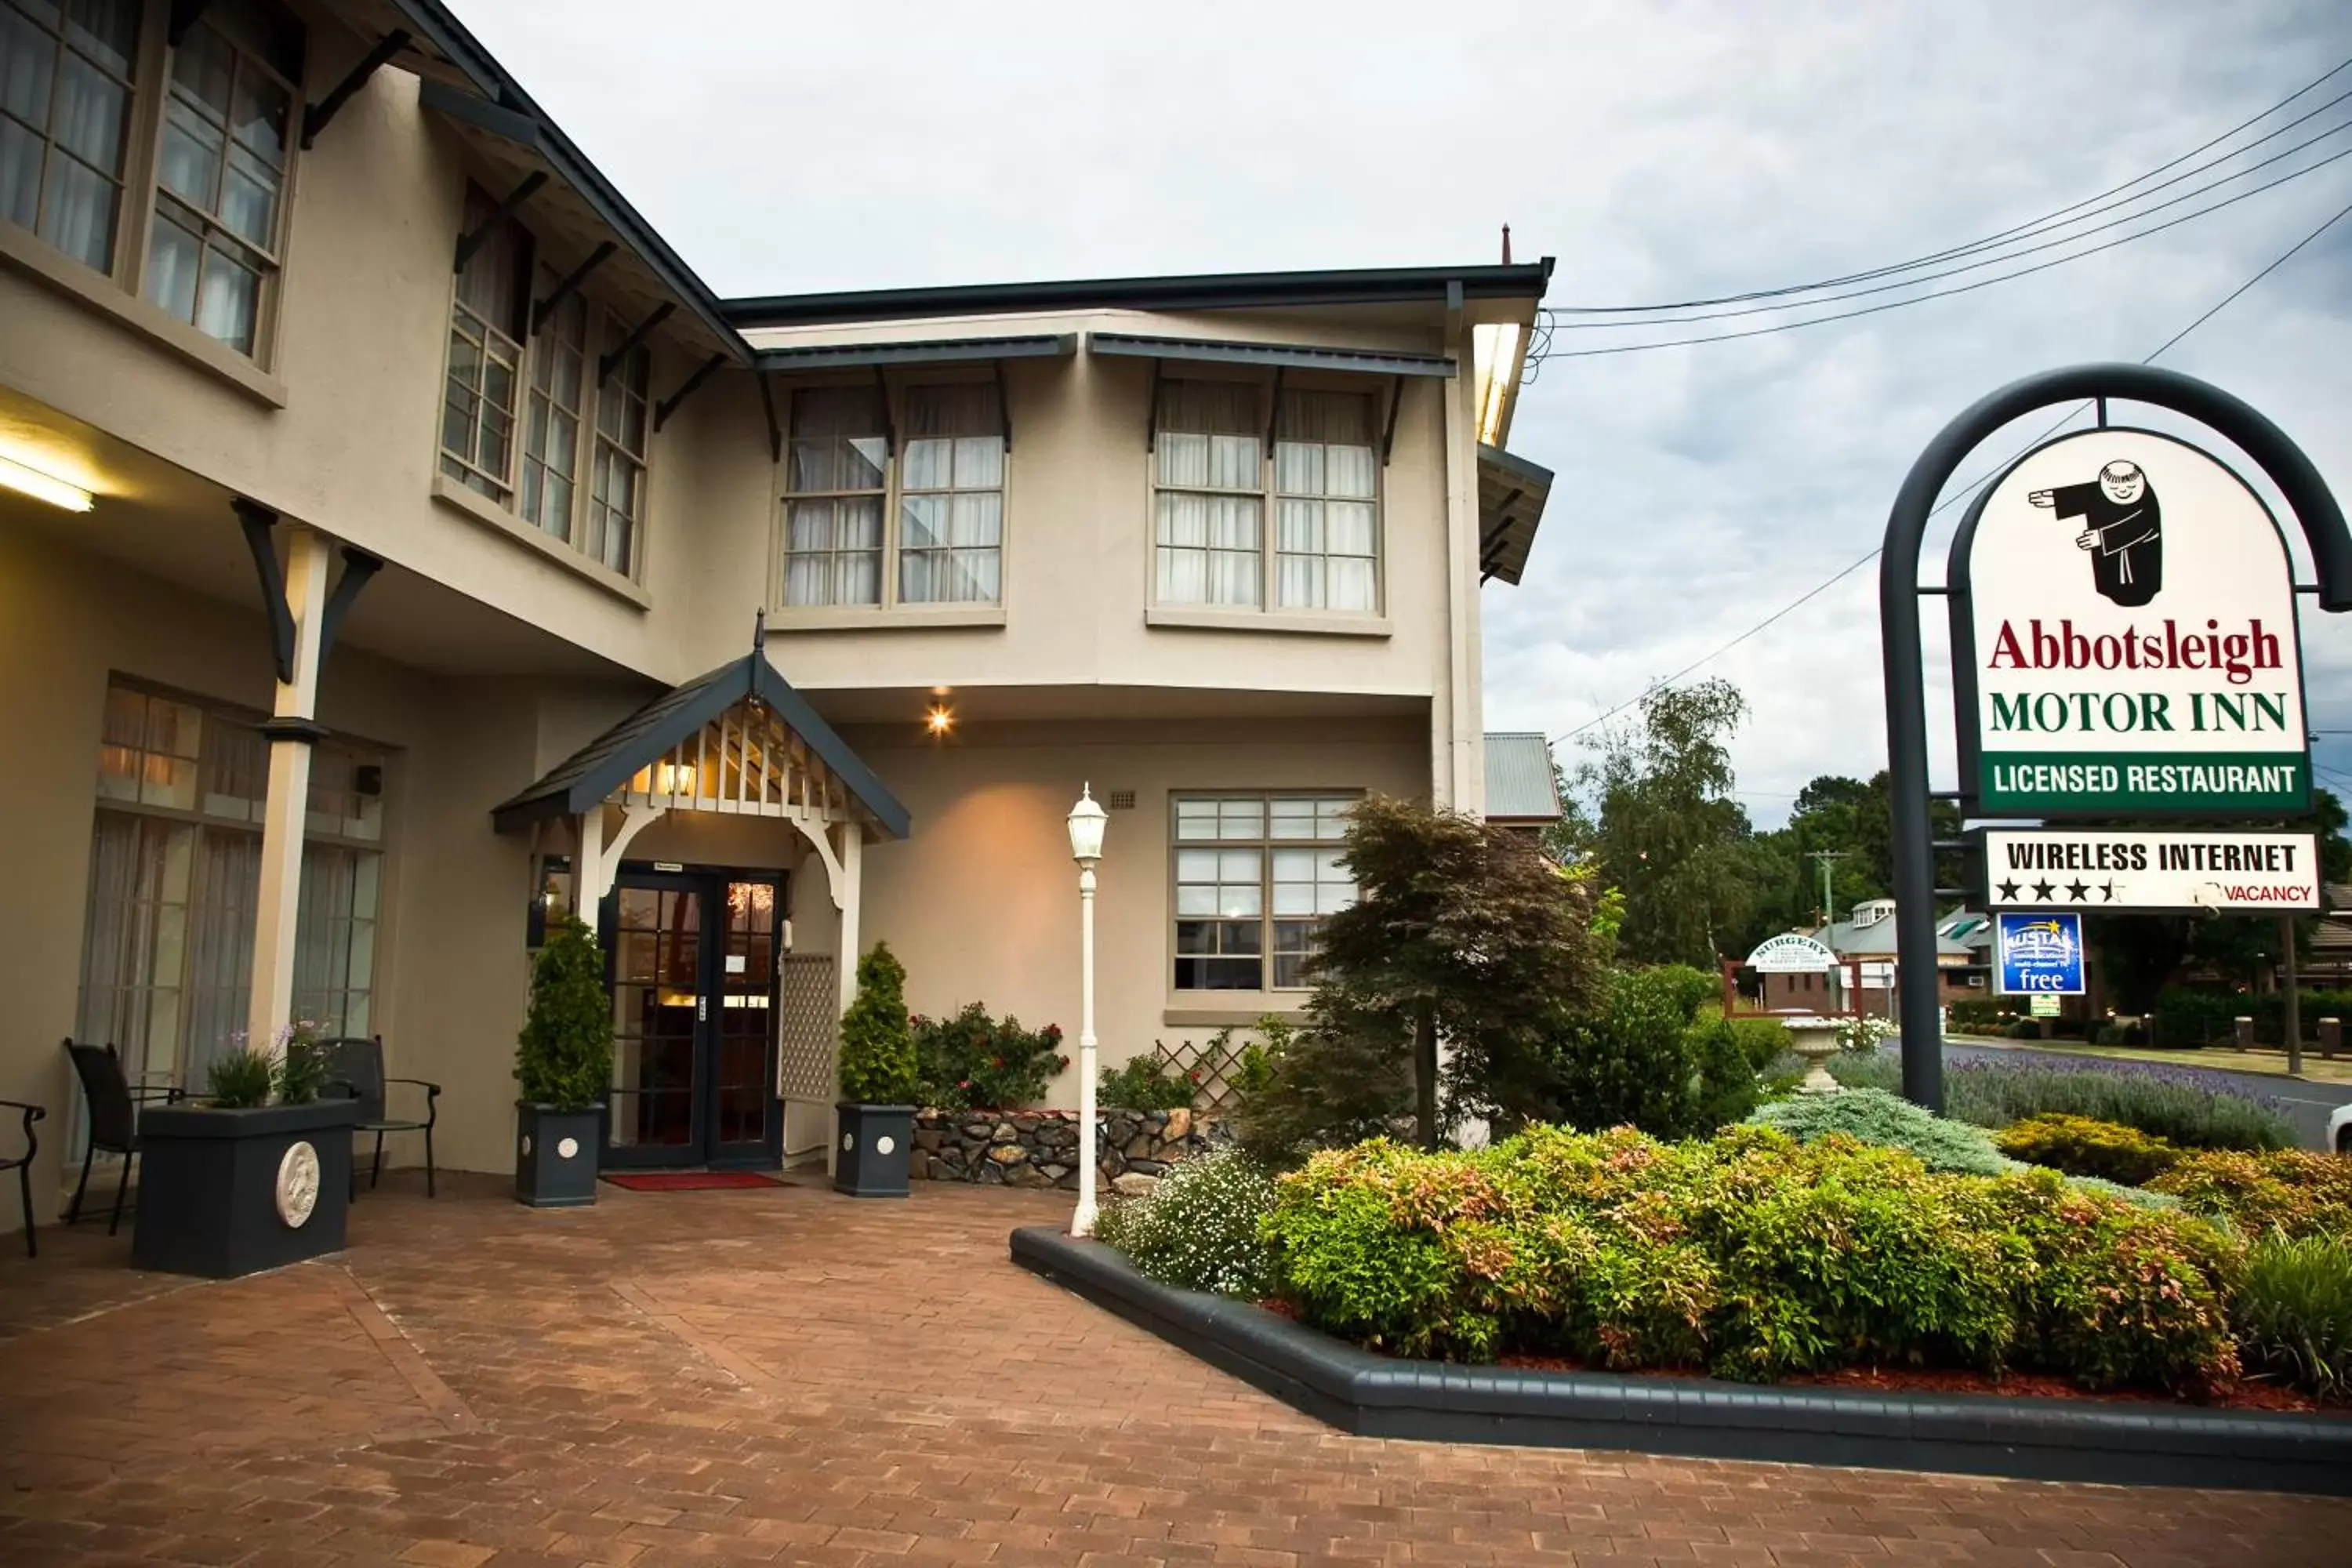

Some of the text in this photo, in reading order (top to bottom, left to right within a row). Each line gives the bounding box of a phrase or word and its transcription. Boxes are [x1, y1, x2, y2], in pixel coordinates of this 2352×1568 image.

[1987, 619, 2283, 684] Abbotsleigh
[1988, 692, 2287, 732] MOTOR INN
[1994, 764, 2296, 793] LICENSED RESTAURANT
[2006, 843, 2296, 873] WIRELESS INTERNET
[2224, 885, 2311, 902] VACANCY
[1755, 937, 1828, 957] SURGERY
[2020, 968, 2063, 990] free
